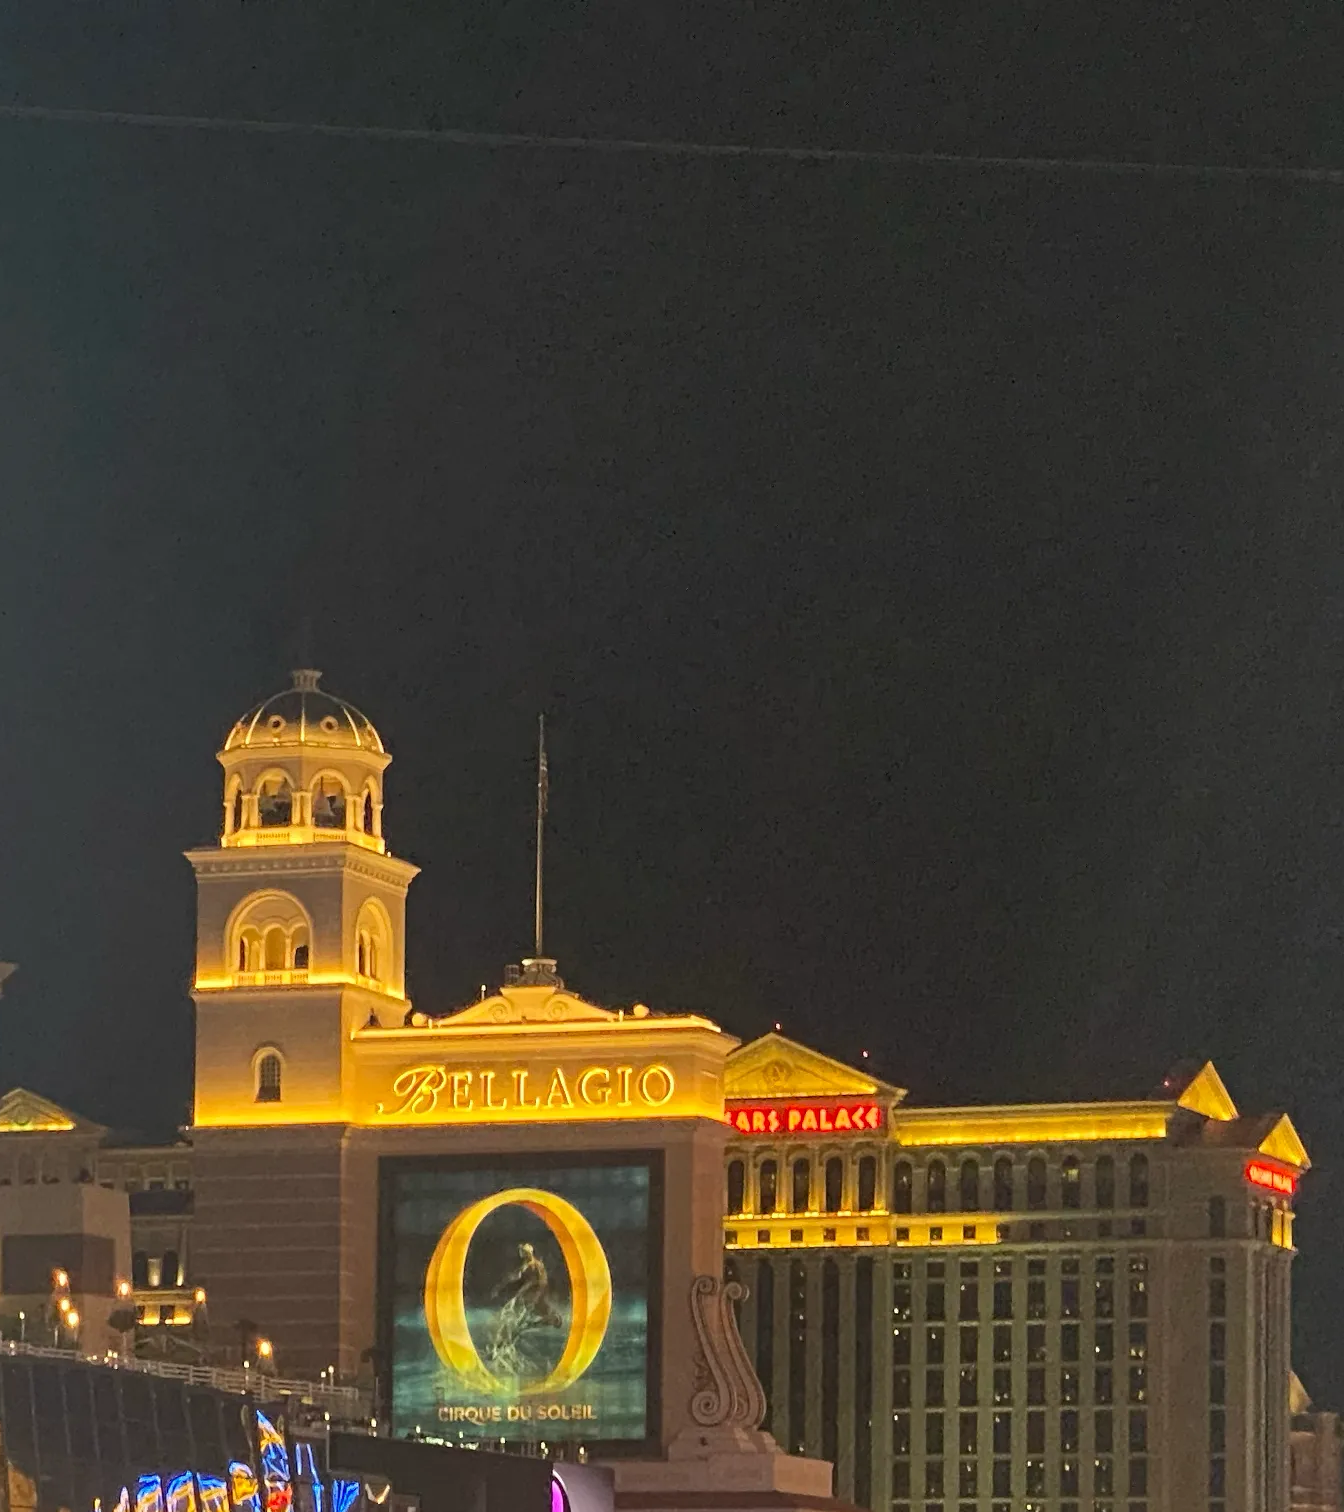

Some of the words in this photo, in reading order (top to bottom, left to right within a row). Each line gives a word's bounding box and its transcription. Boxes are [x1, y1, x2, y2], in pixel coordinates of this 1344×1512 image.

[374, 1063, 676, 1116] BELLAGIO
[786, 1106, 878, 1132] PALACE
[437, 1405, 503, 1426] CIRQUE
[507, 1404, 533, 1422] DU
[537, 1403, 598, 1421] SOLEIL
